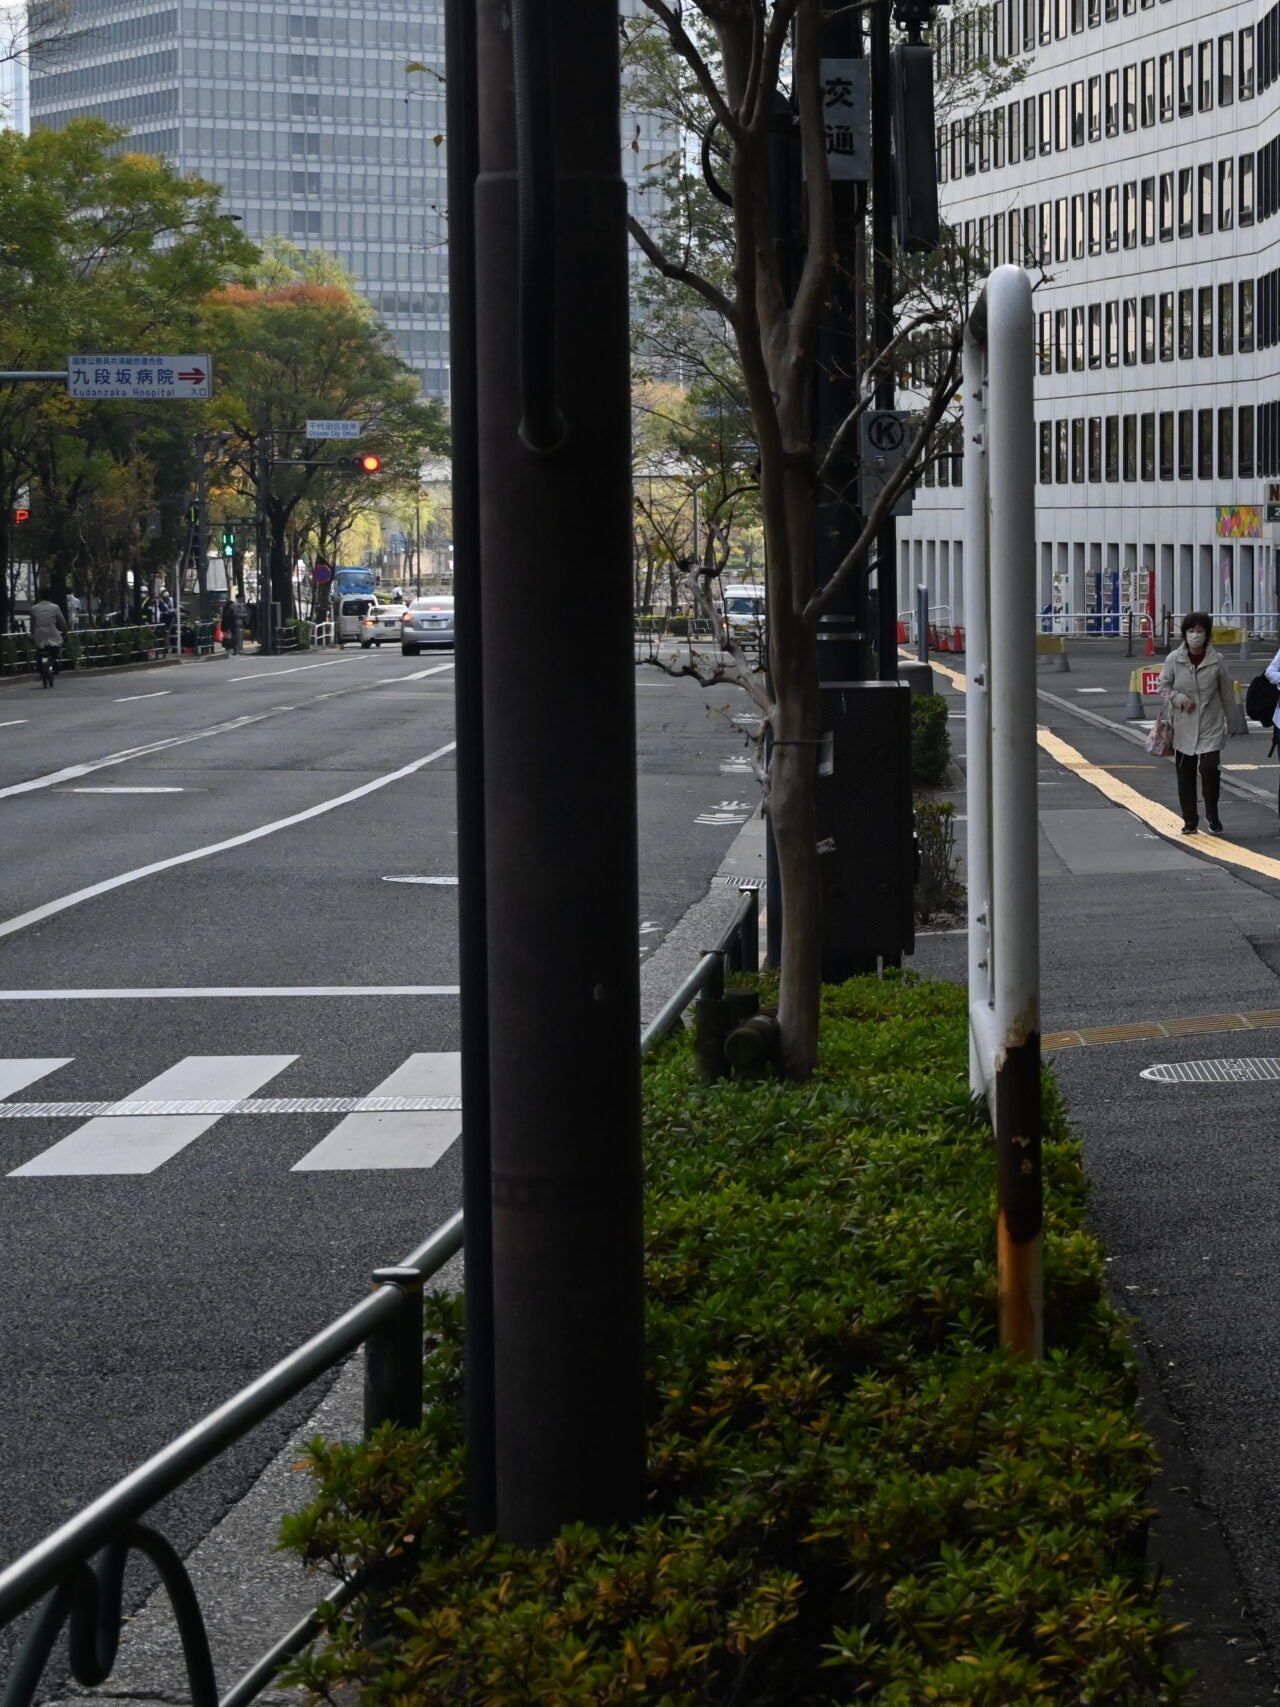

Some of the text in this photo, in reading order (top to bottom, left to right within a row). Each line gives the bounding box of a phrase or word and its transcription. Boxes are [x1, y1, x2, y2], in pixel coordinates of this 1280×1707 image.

[825, 77, 855, 155] 交通
[72, 368, 175, 385] 九段坂病院
[72, 388, 175, 398] Kudanzaka Hospital
[190, 388, 207, 396] 入口
[309, 422, 357, 431] 千代田区役所
[876, 421, 897, 446] K
[15, 509, 30, 524] P
